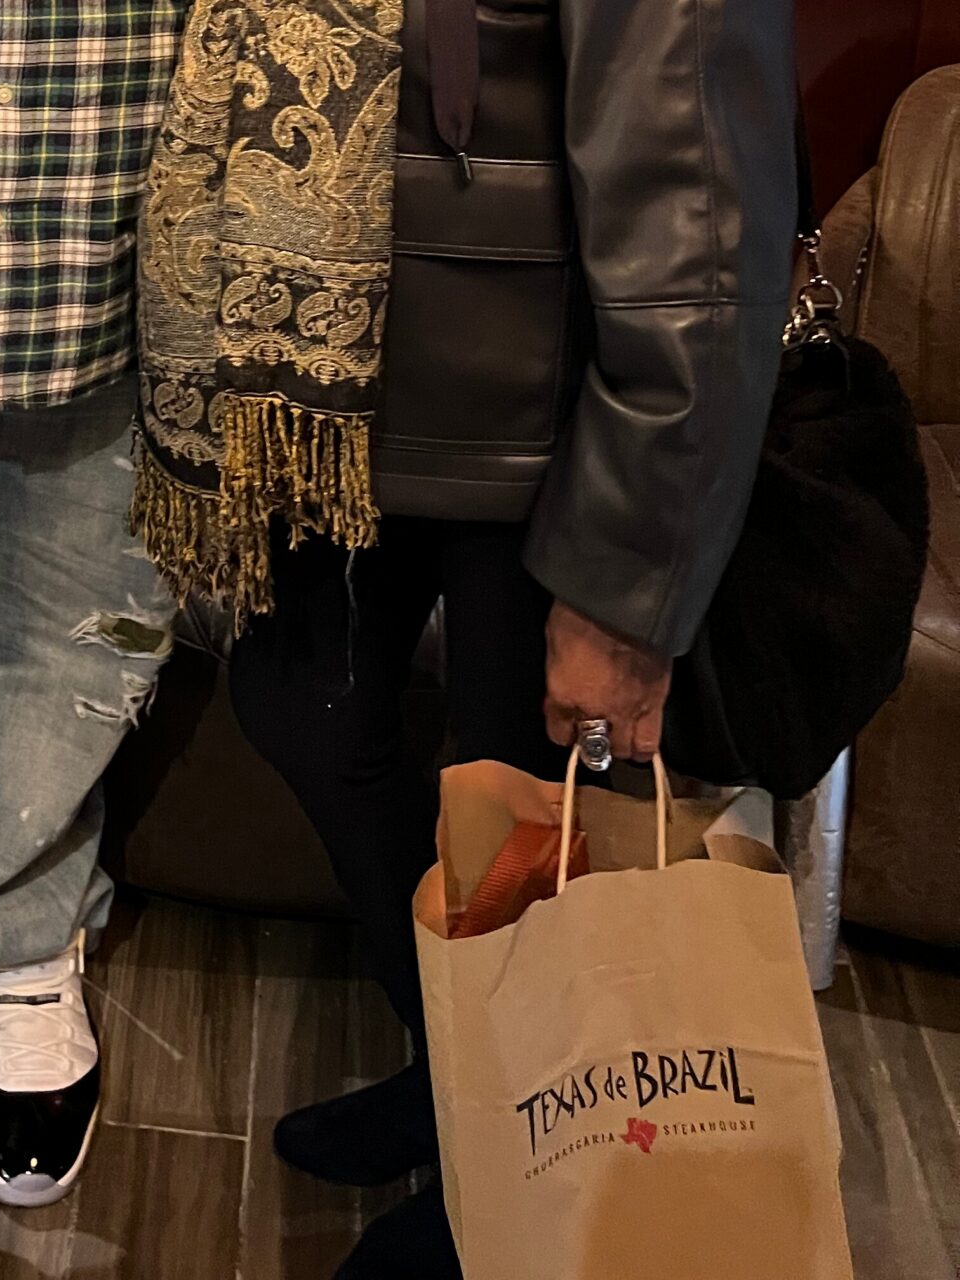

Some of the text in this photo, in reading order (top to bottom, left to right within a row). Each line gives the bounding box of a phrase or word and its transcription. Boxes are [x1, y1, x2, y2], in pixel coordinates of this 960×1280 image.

[516, 1065, 597, 1157] TEXAS
[603, 1066, 628, 1100] de
[663, 1120, 756, 1136] STEAKHOUSE
